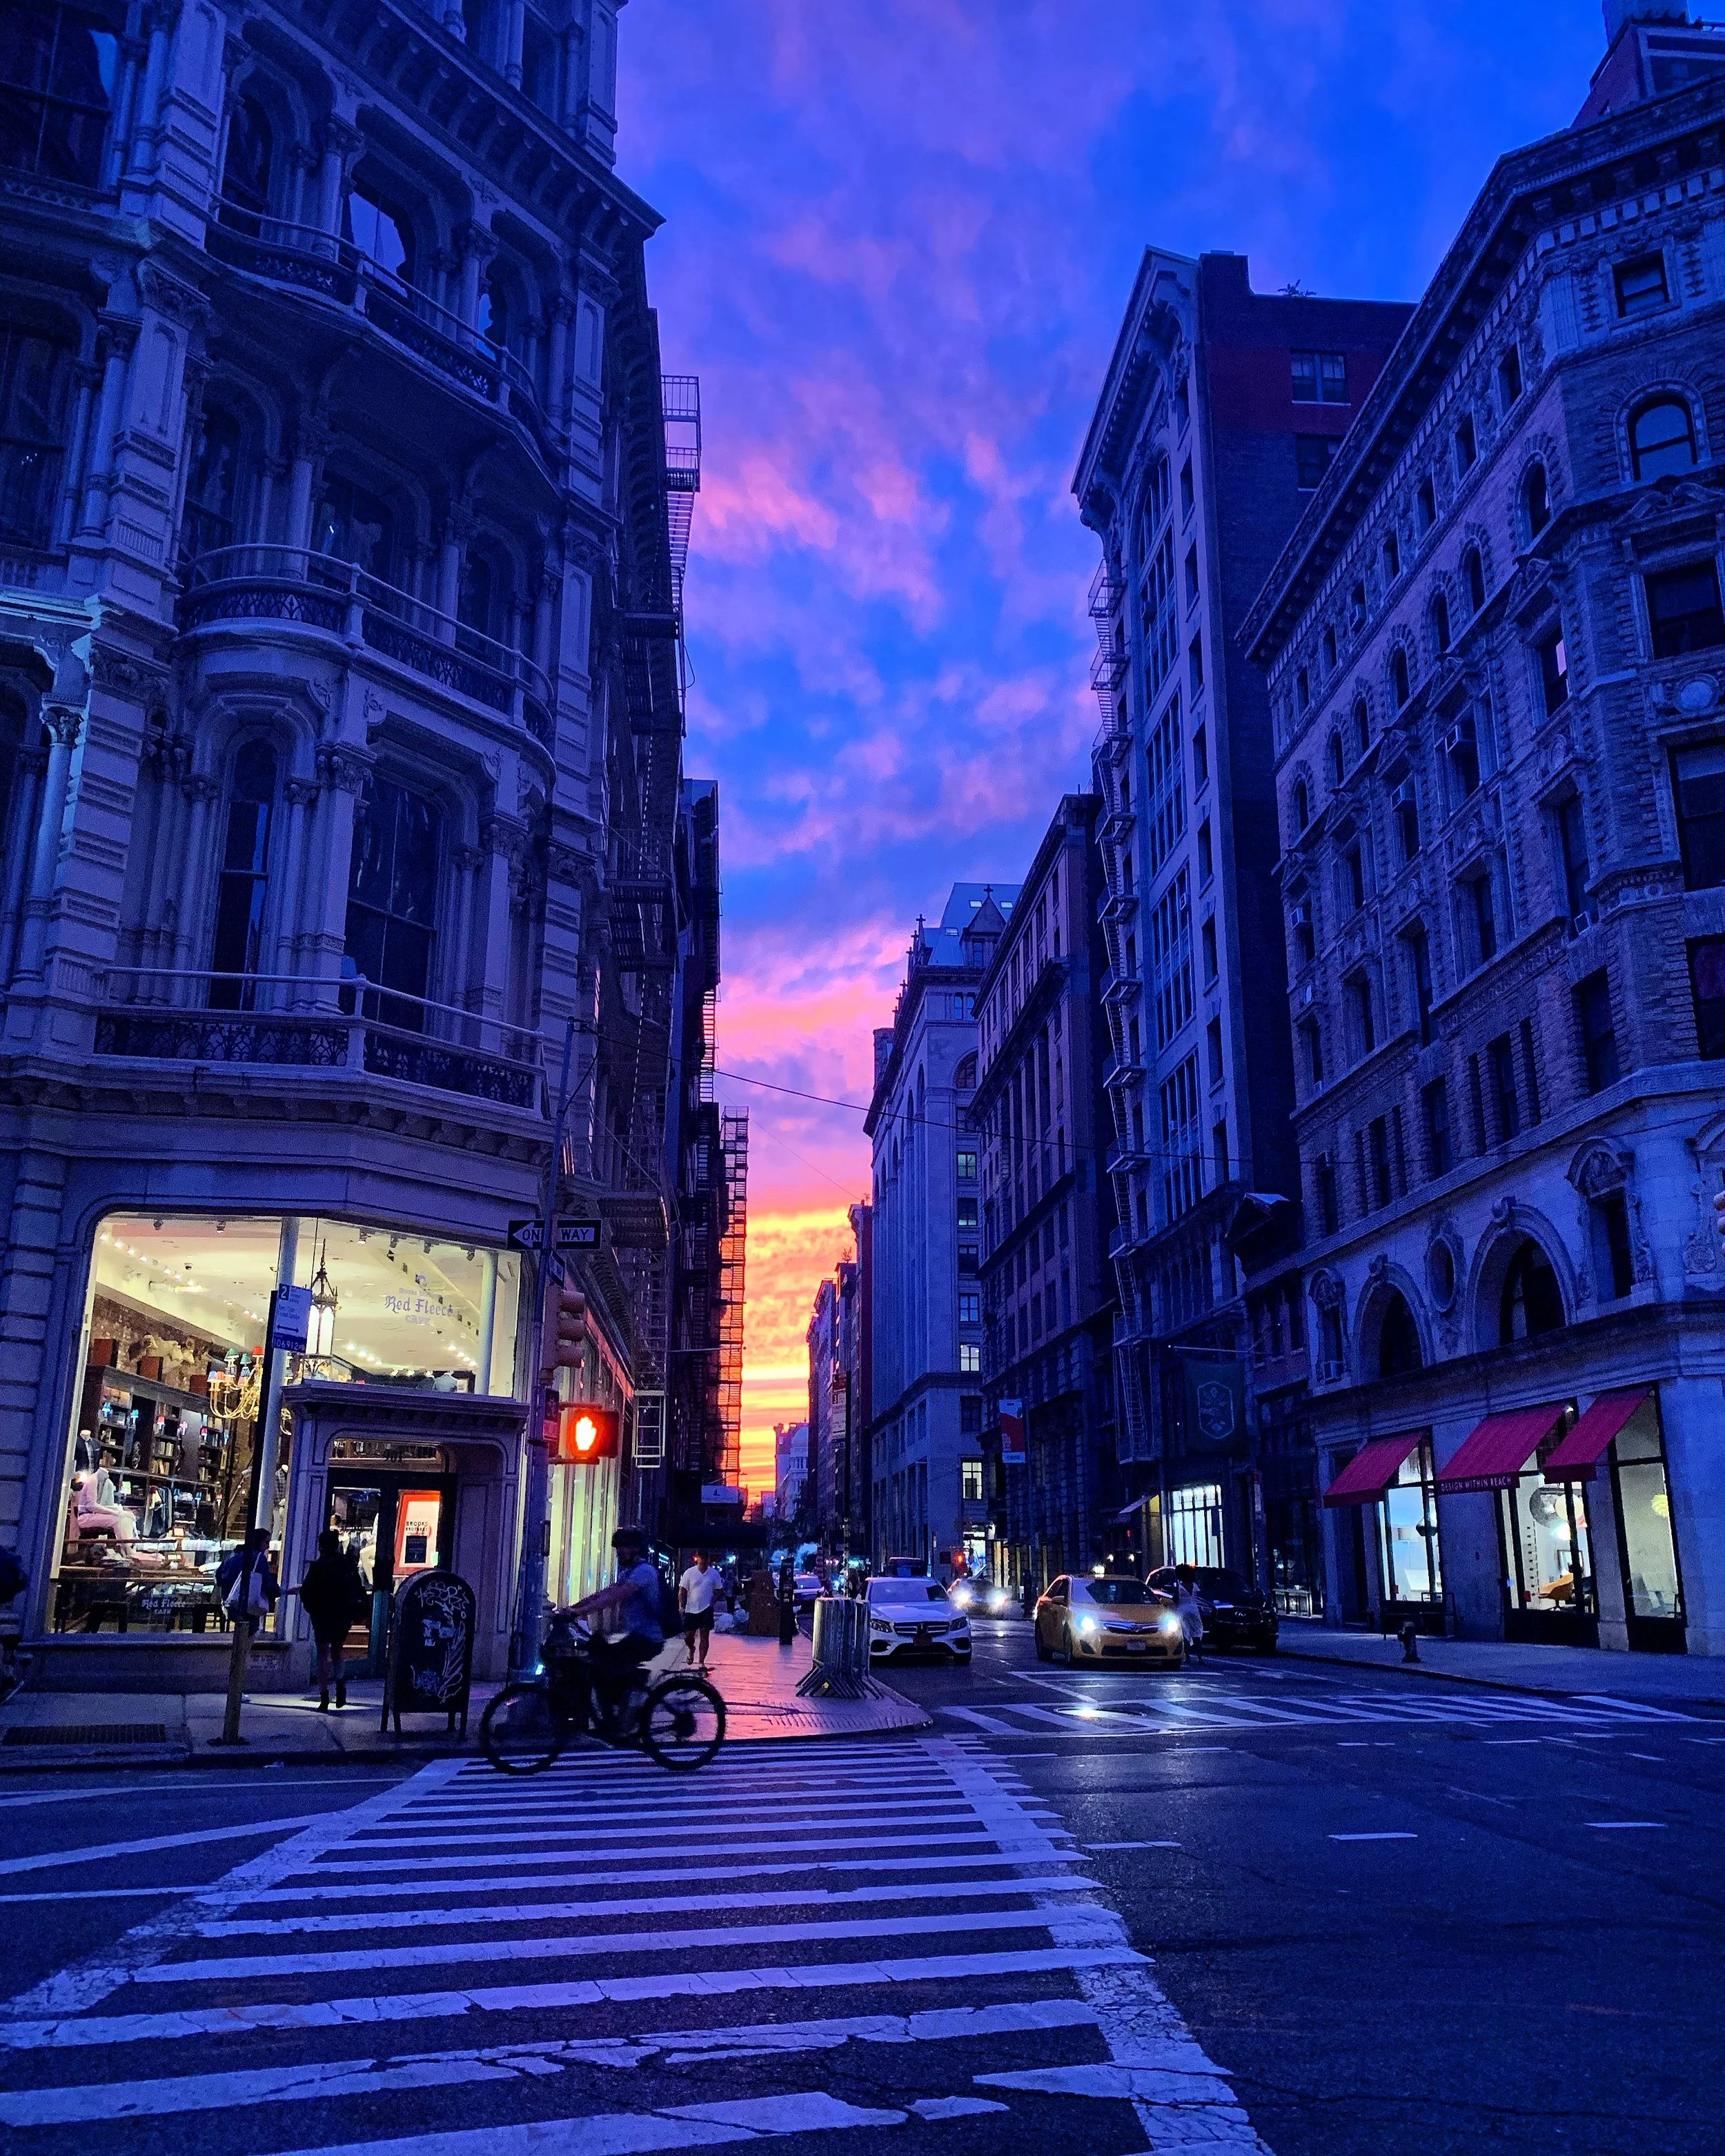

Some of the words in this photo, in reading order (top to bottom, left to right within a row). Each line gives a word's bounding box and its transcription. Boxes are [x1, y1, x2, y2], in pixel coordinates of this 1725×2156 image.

[522, 1229, 544, 1241] ON
[561, 1229, 589, 1241] WAY
[281, 1285, 287, 1298] 2
[384, 1296, 411, 1314] Red
[1441, 1482, 1463, 1492] DESIGN
[1465, 1478, 1488, 1488] WITHIN
[1490, 1476, 1511, 1487] REACH
